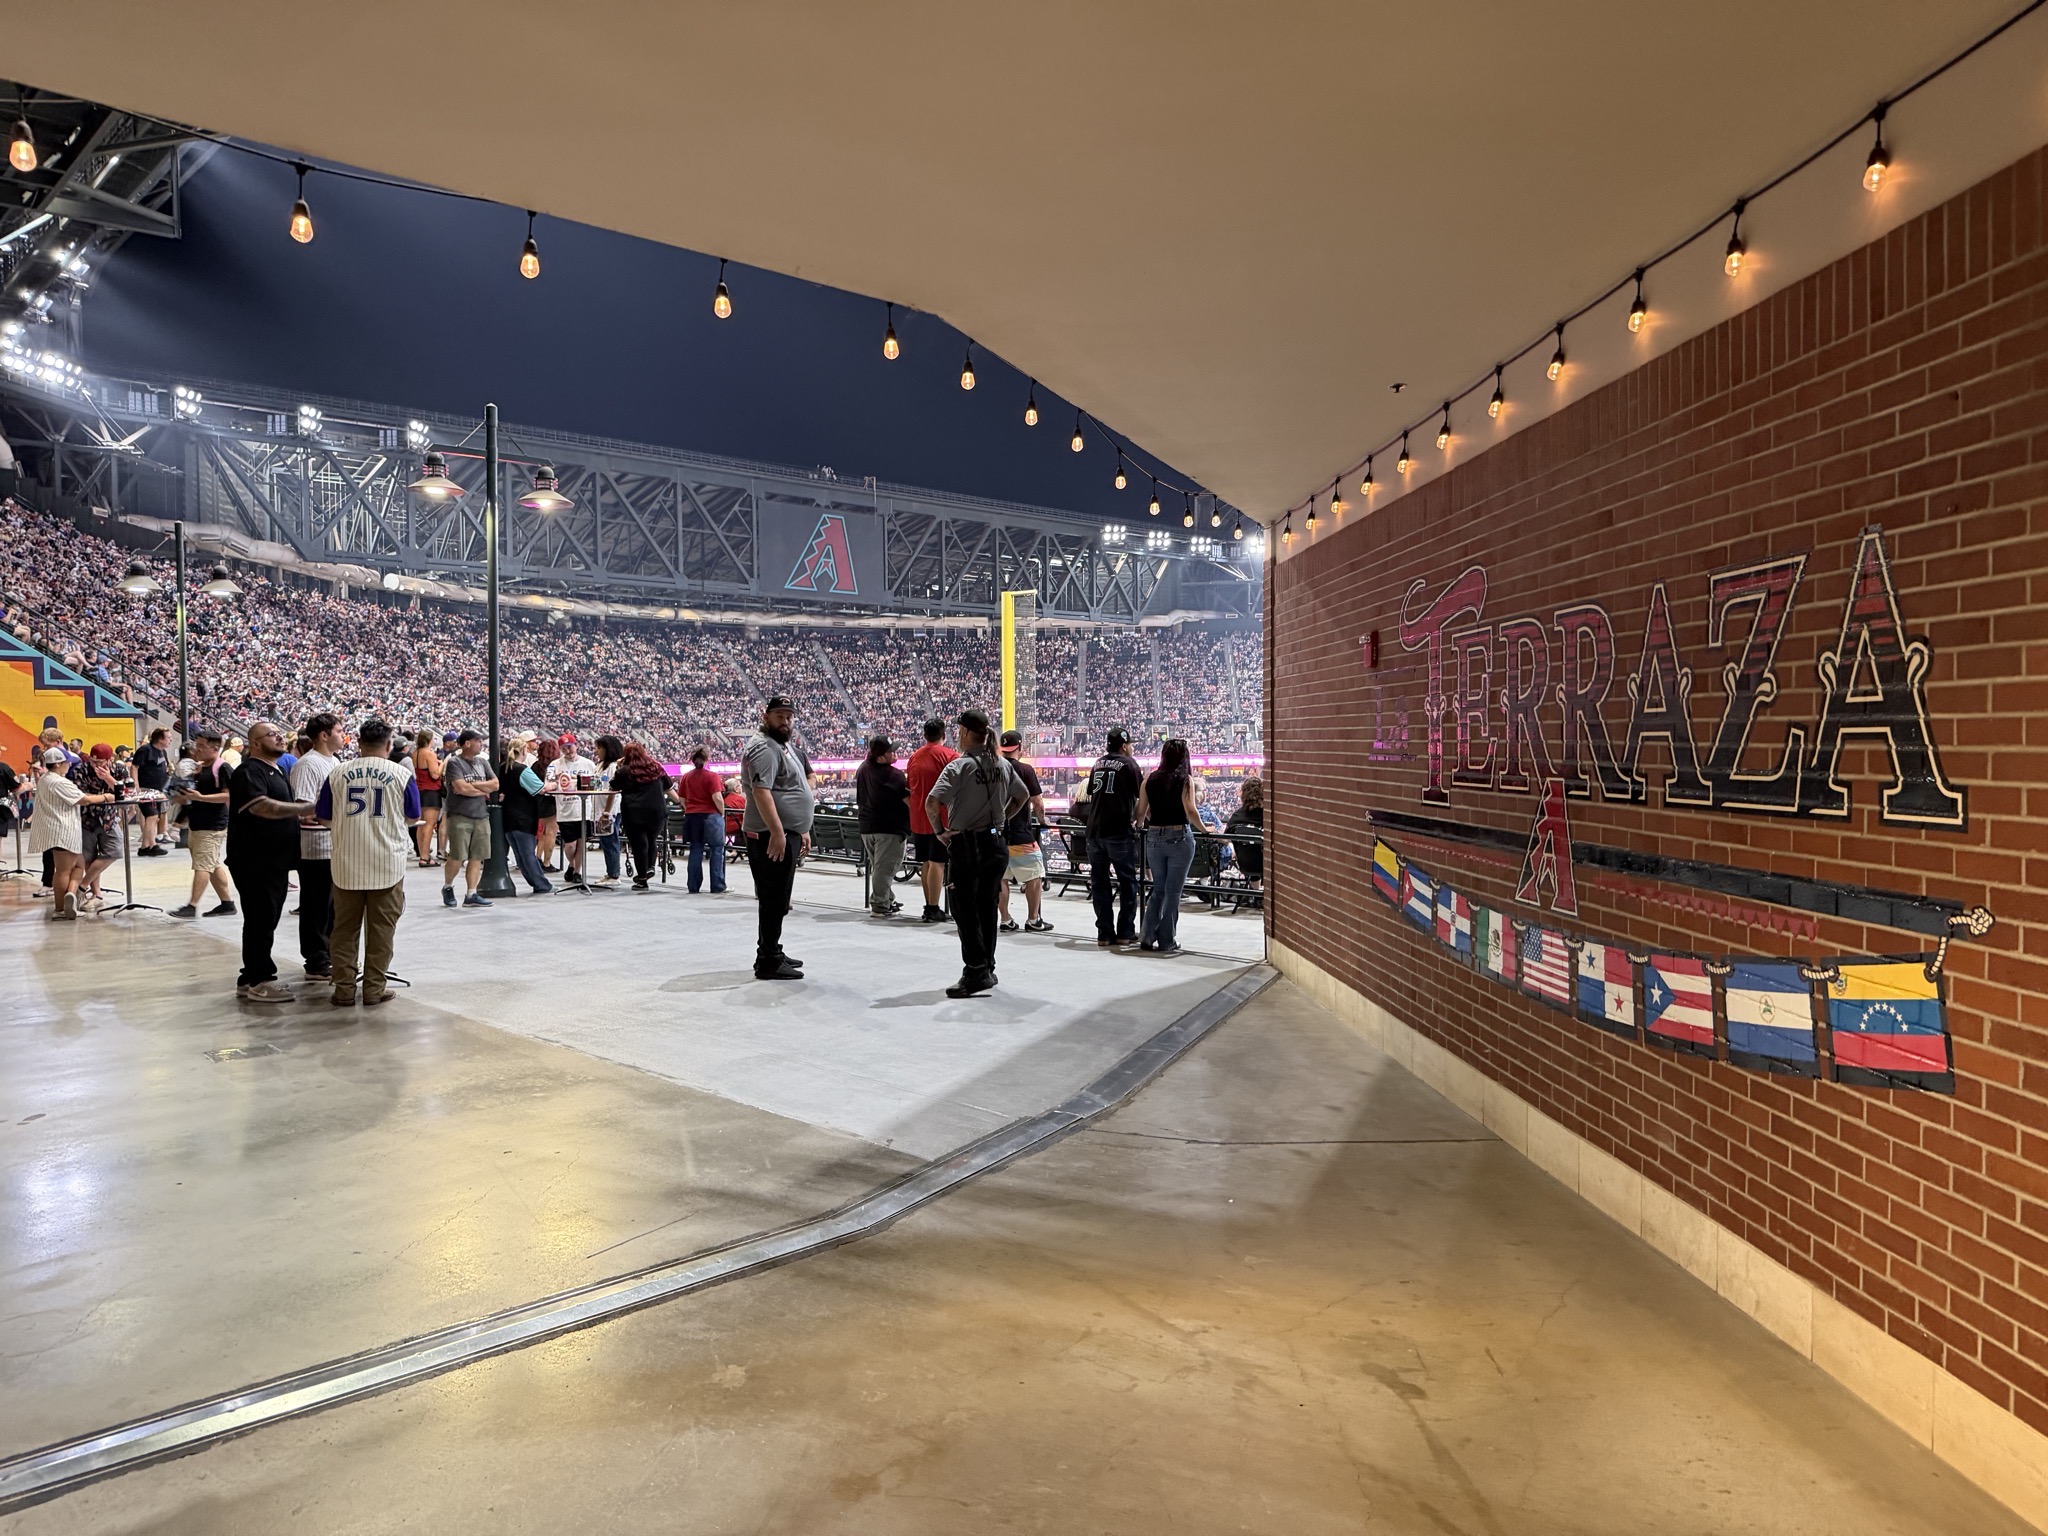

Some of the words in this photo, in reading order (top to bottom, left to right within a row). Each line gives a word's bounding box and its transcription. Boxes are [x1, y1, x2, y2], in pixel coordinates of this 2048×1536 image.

[784, 513, 859, 595] A
[1400, 524, 1969, 831] TERRAZA
[342, 766, 395, 785] JOHNSON
[346, 786, 386, 819] 51
[1092, 770, 1116, 794] 51
[1514, 776, 1579, 918] A
